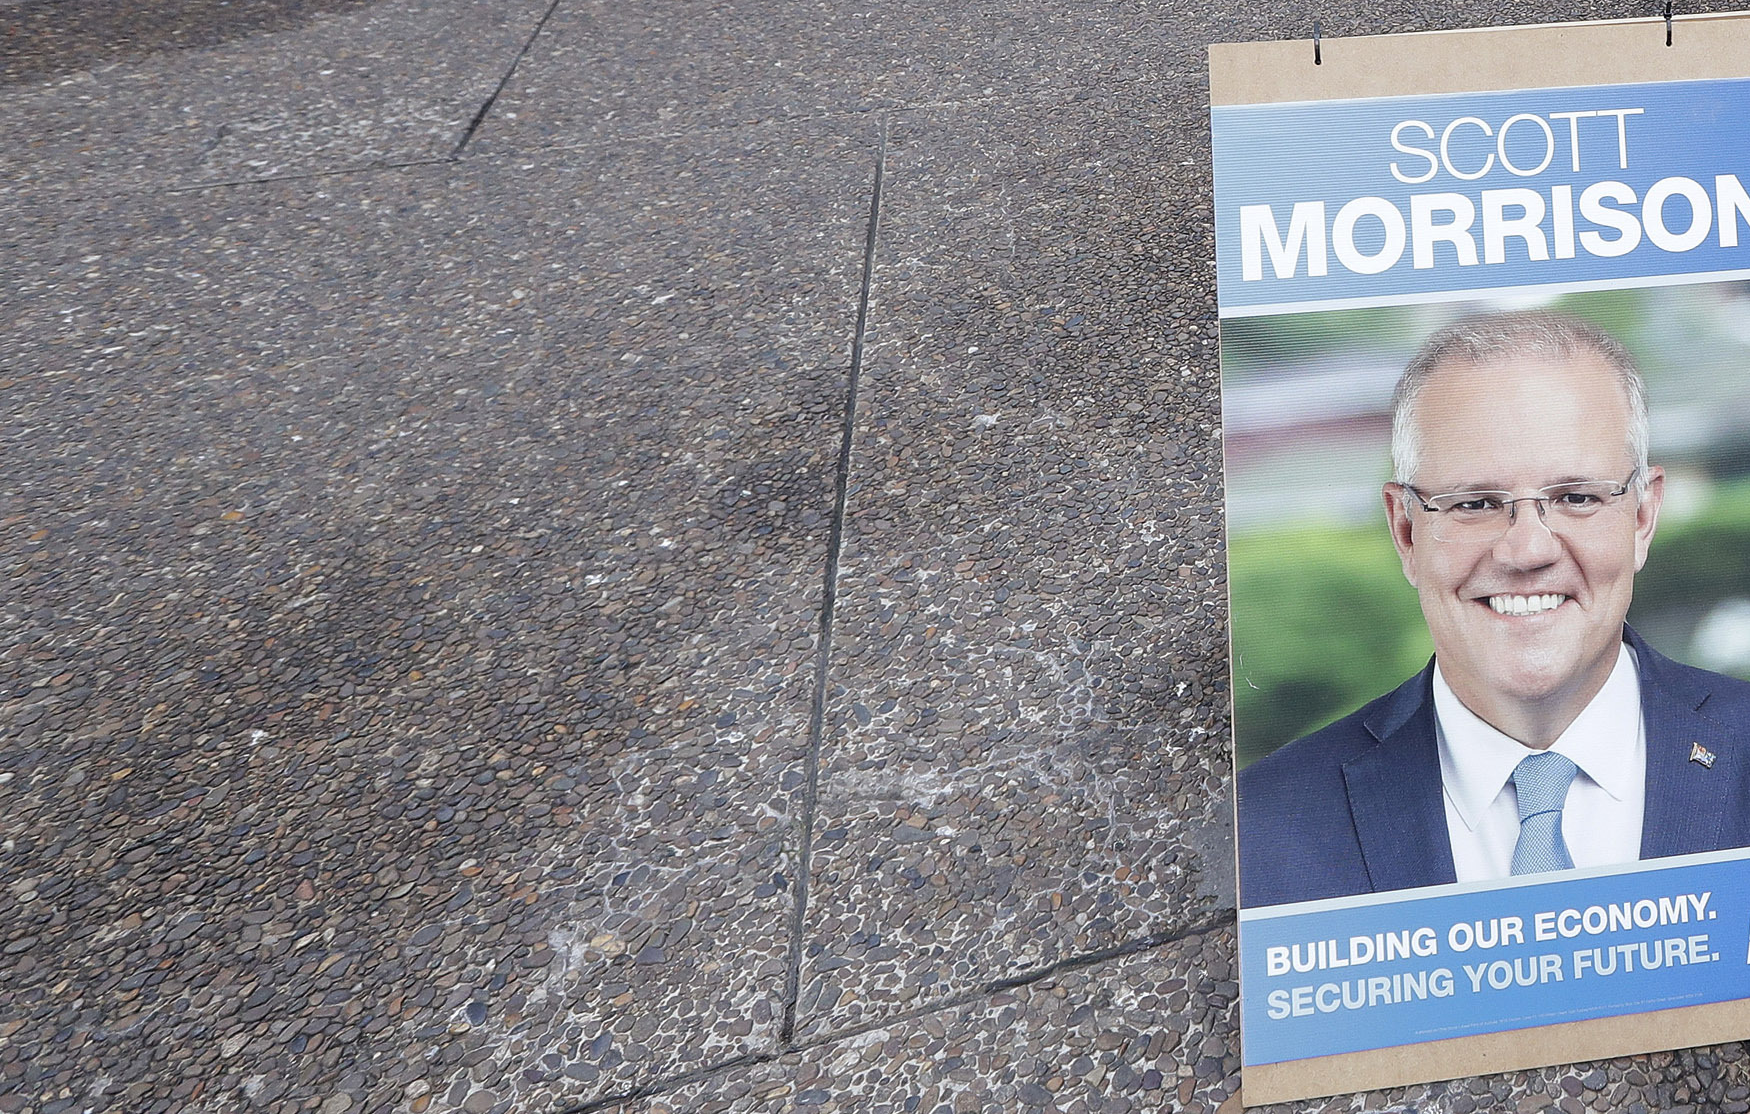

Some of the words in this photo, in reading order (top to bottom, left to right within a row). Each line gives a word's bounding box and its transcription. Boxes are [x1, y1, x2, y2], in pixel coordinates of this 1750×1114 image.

[1389, 107, 1644, 184] SCOTT
[1266, 931, 1438, 976] BUILDING
[1447, 915, 1524, 952] OUR
[1534, 892, 1717, 941] ECONOMY.
[1267, 968, 1455, 1020] SECURING
[1462, 948, 1564, 991] YOUR
[1574, 933, 1720, 982] FUTURE.
